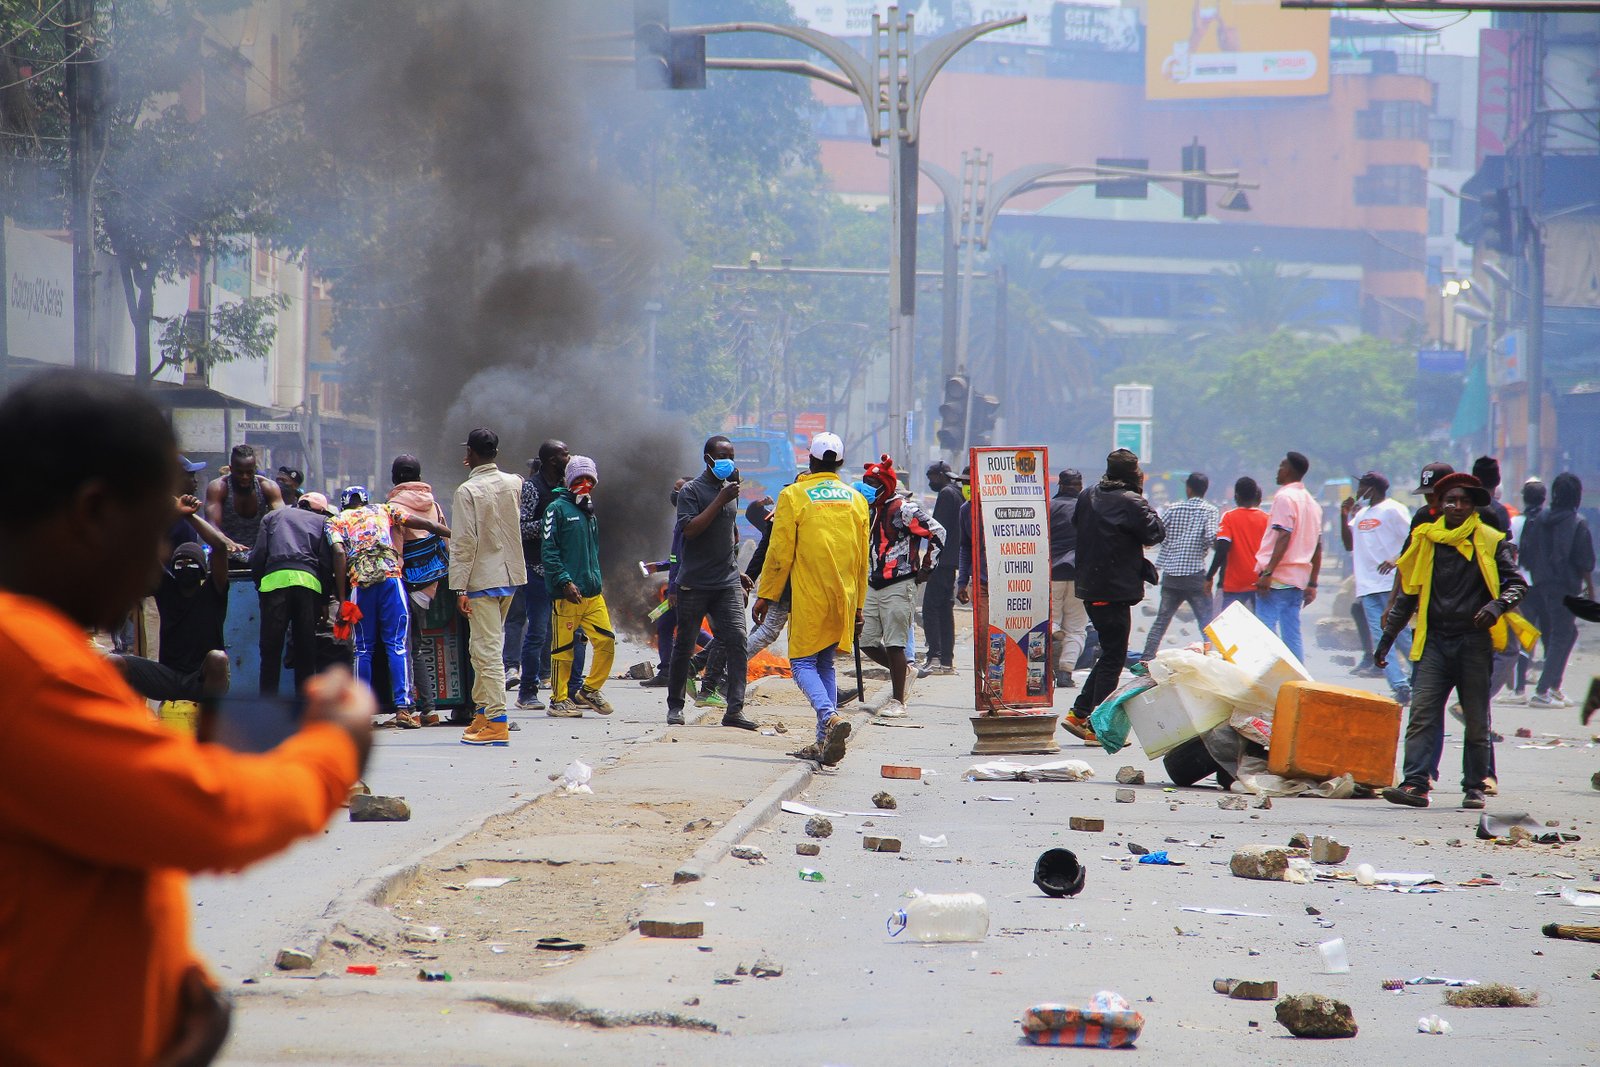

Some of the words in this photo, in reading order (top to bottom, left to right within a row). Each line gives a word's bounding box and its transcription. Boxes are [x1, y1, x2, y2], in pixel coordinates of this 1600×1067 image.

[11, 272, 33, 320] Galaxy
[44, 279, 64, 318] Series
[275, 423, 299, 432] STREET
[988, 456, 1016, 471] ROUTE
[984, 473, 1003, 485] KMO
[1014, 474, 1037, 484] DIGITAL
[982, 485, 1007, 496] SACCO
[1010, 486, 1032, 496] LUXURY
[1032, 486, 1043, 496] LTD
[996, 508, 1008, 518] New
[1008, 508, 1022, 518] Route
[1022, 508, 1034, 519] Alert
[992, 523, 1041, 538] WESTLANDS
[1000, 542, 1036, 556] KANGEMI
[1004, 560, 1034, 574] UTHIRU
[1007, 579, 1032, 593] KINOO
[1006, 598, 1032, 611] REGEN
[1005, 616, 1033, 630] KIKUYU
[437, 643, 445, 676] AGENT
